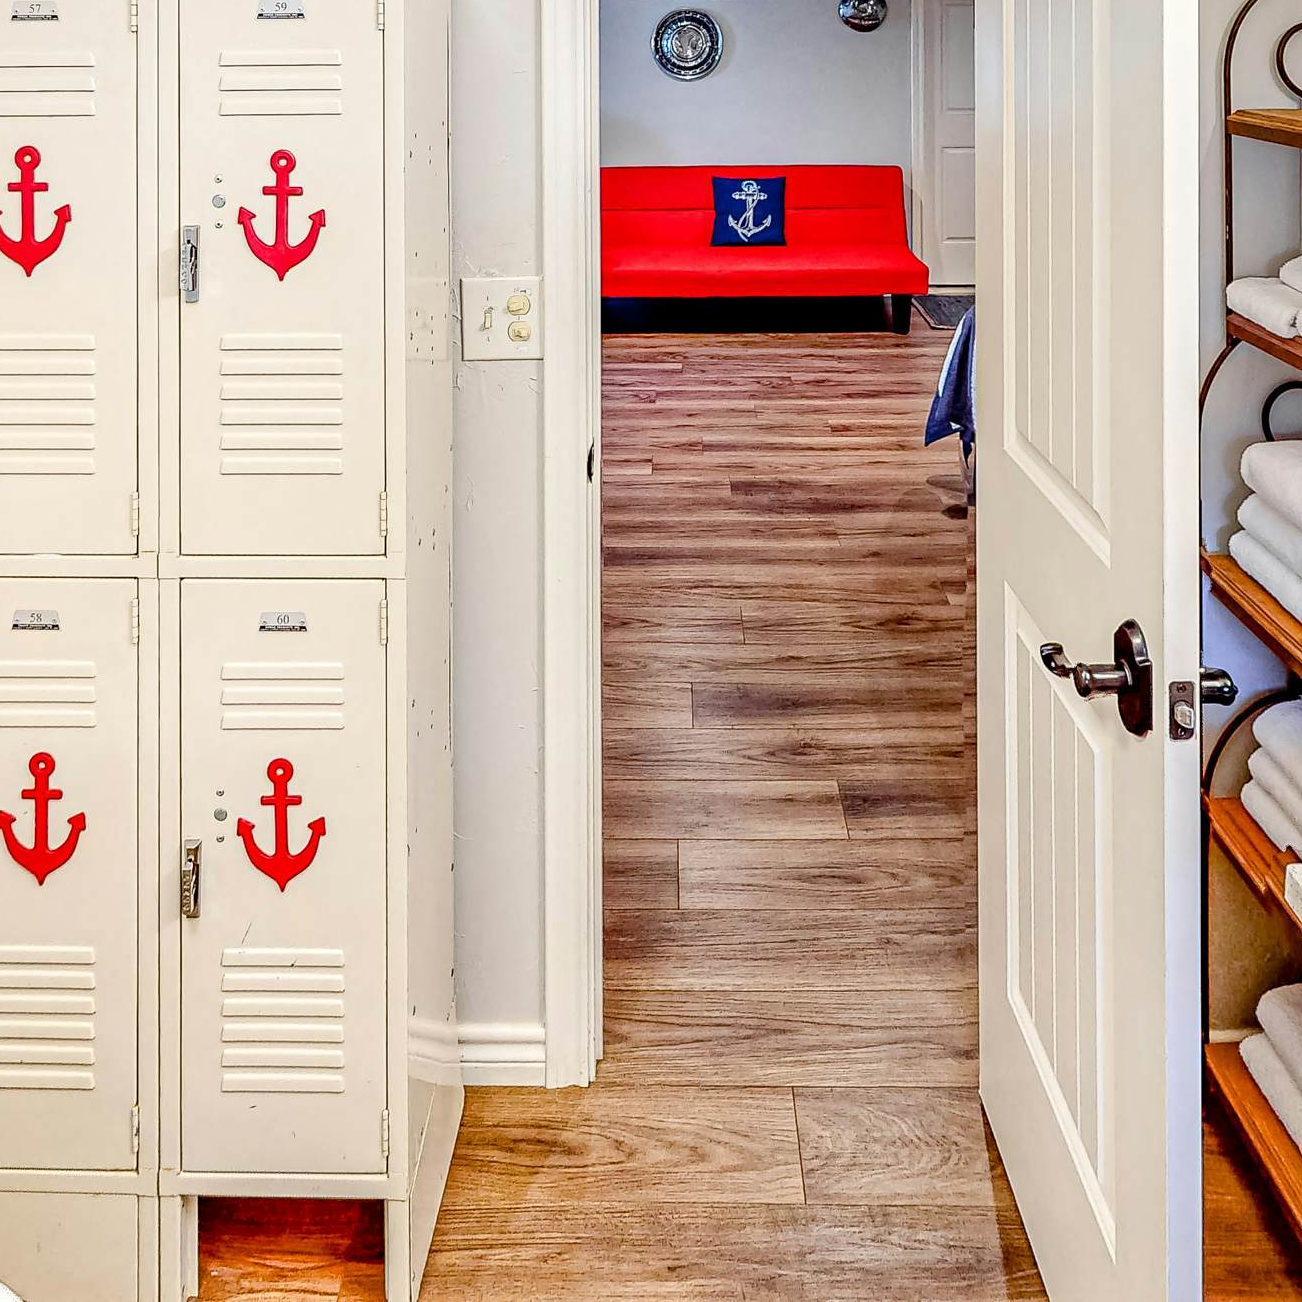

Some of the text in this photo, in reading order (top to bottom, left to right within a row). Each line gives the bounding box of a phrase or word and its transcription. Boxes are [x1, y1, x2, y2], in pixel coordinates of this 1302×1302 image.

[28, 3, 41, 14] 57
[274, 1, 288, 12] 59
[29, 612, 42, 623] 58
[276, 614, 290, 624] 60
